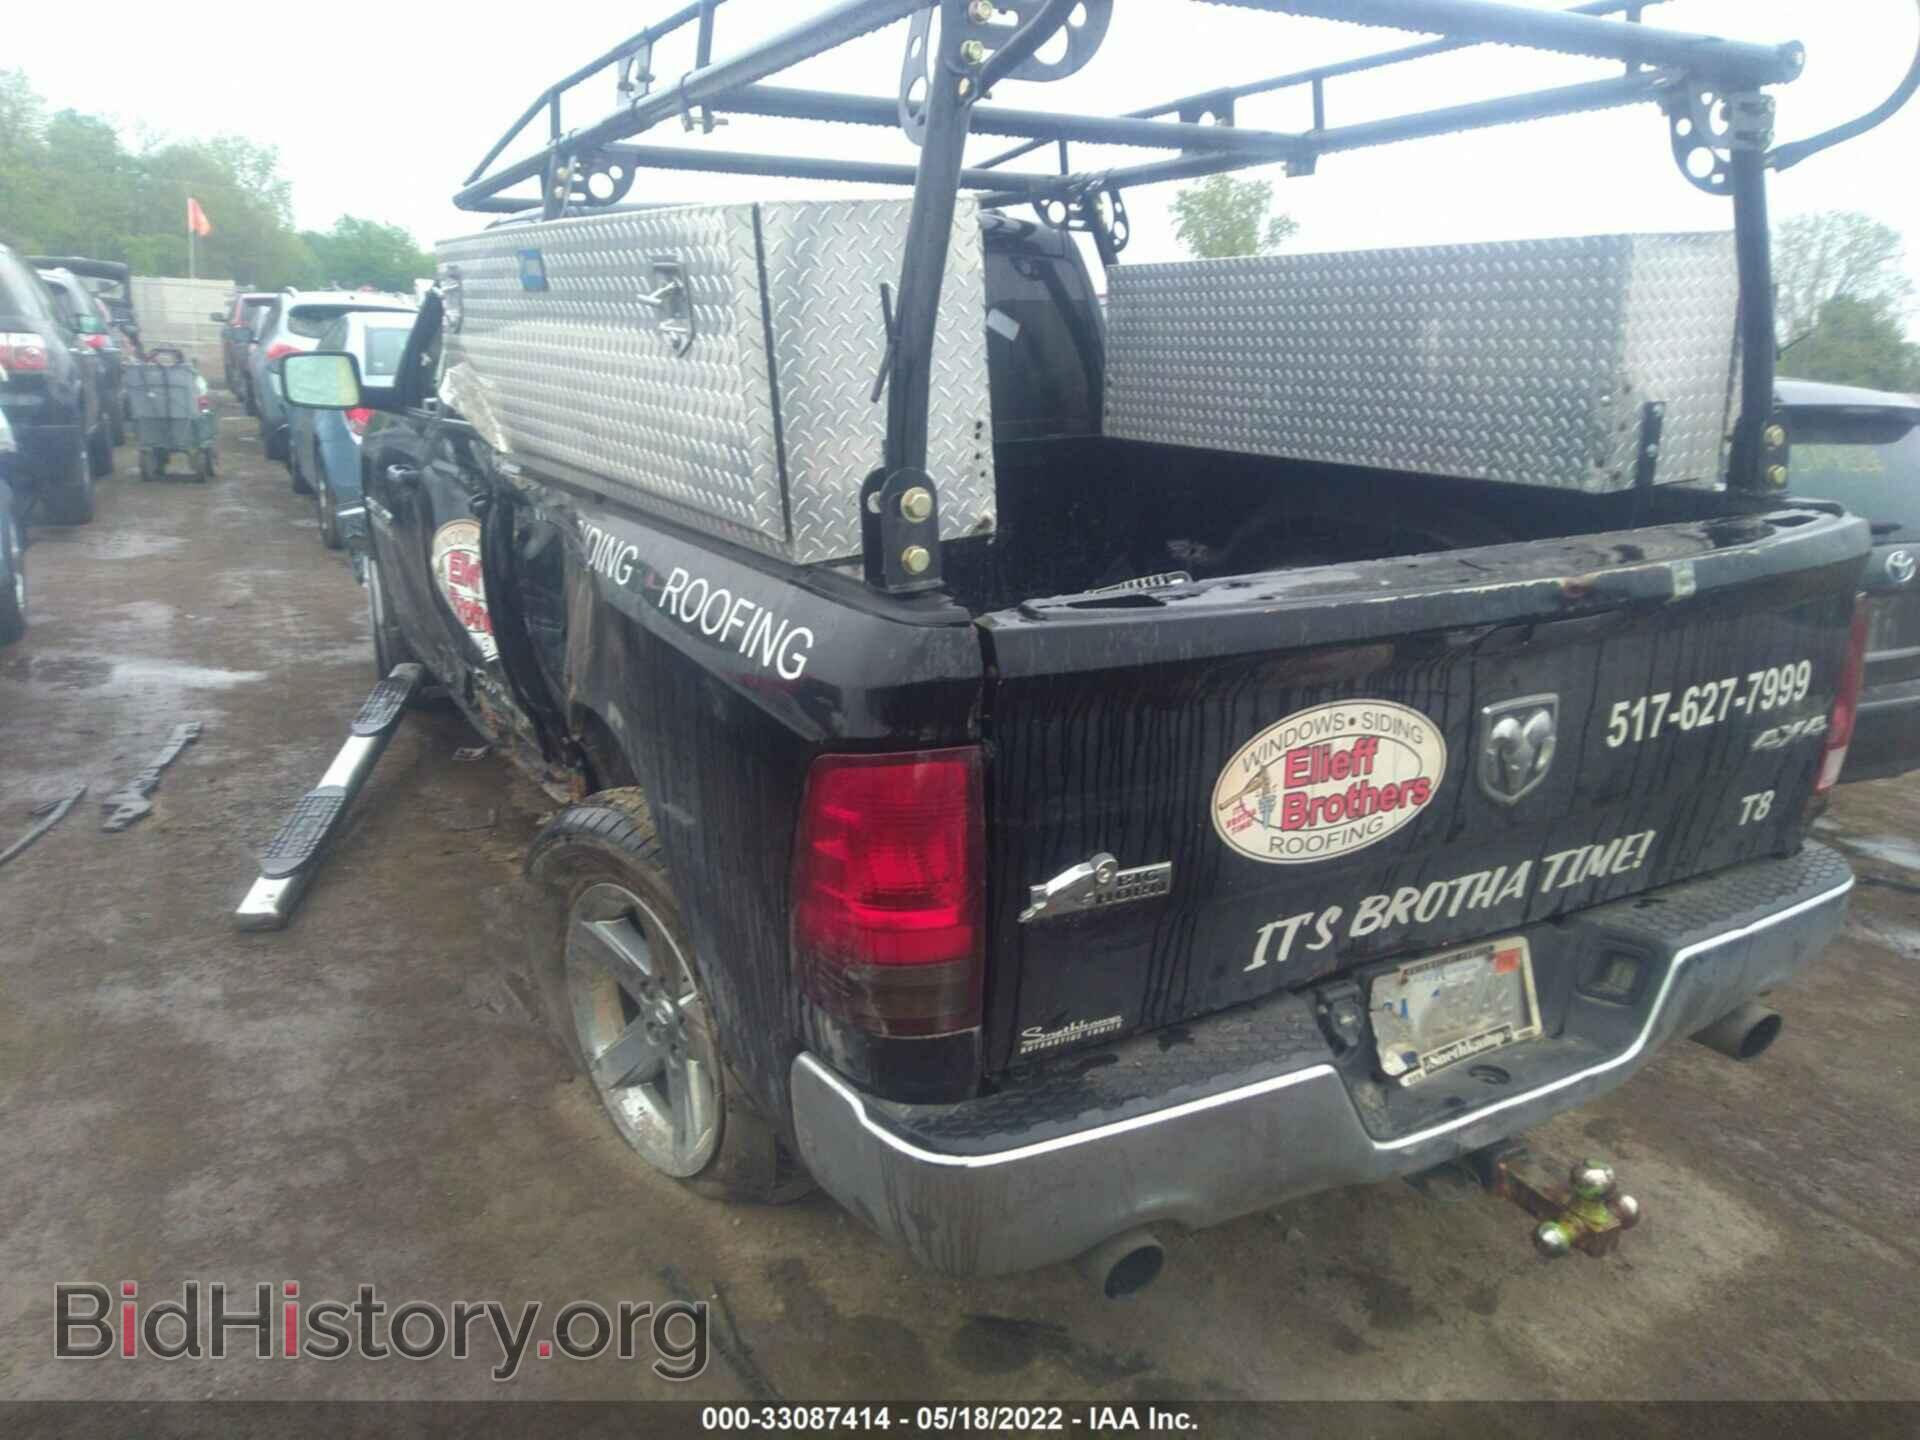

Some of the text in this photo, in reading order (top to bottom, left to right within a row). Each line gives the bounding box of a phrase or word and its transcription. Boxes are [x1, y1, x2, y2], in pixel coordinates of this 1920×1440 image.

[658, 566, 814, 680] ROOFING
[1605, 659, 1812, 748] 517-627-7999
[1242, 711, 1424, 773] WINDOWS SIDING
[1284, 735, 1379, 789] Elieff
[1281, 776, 1432, 832] Brothers
[1738, 789, 1776, 826] T8
[1268, 815, 1384, 854] ROOFING
[1348, 859, 1533, 939] BROTHA
[1540, 829, 1657, 894] TIME!
